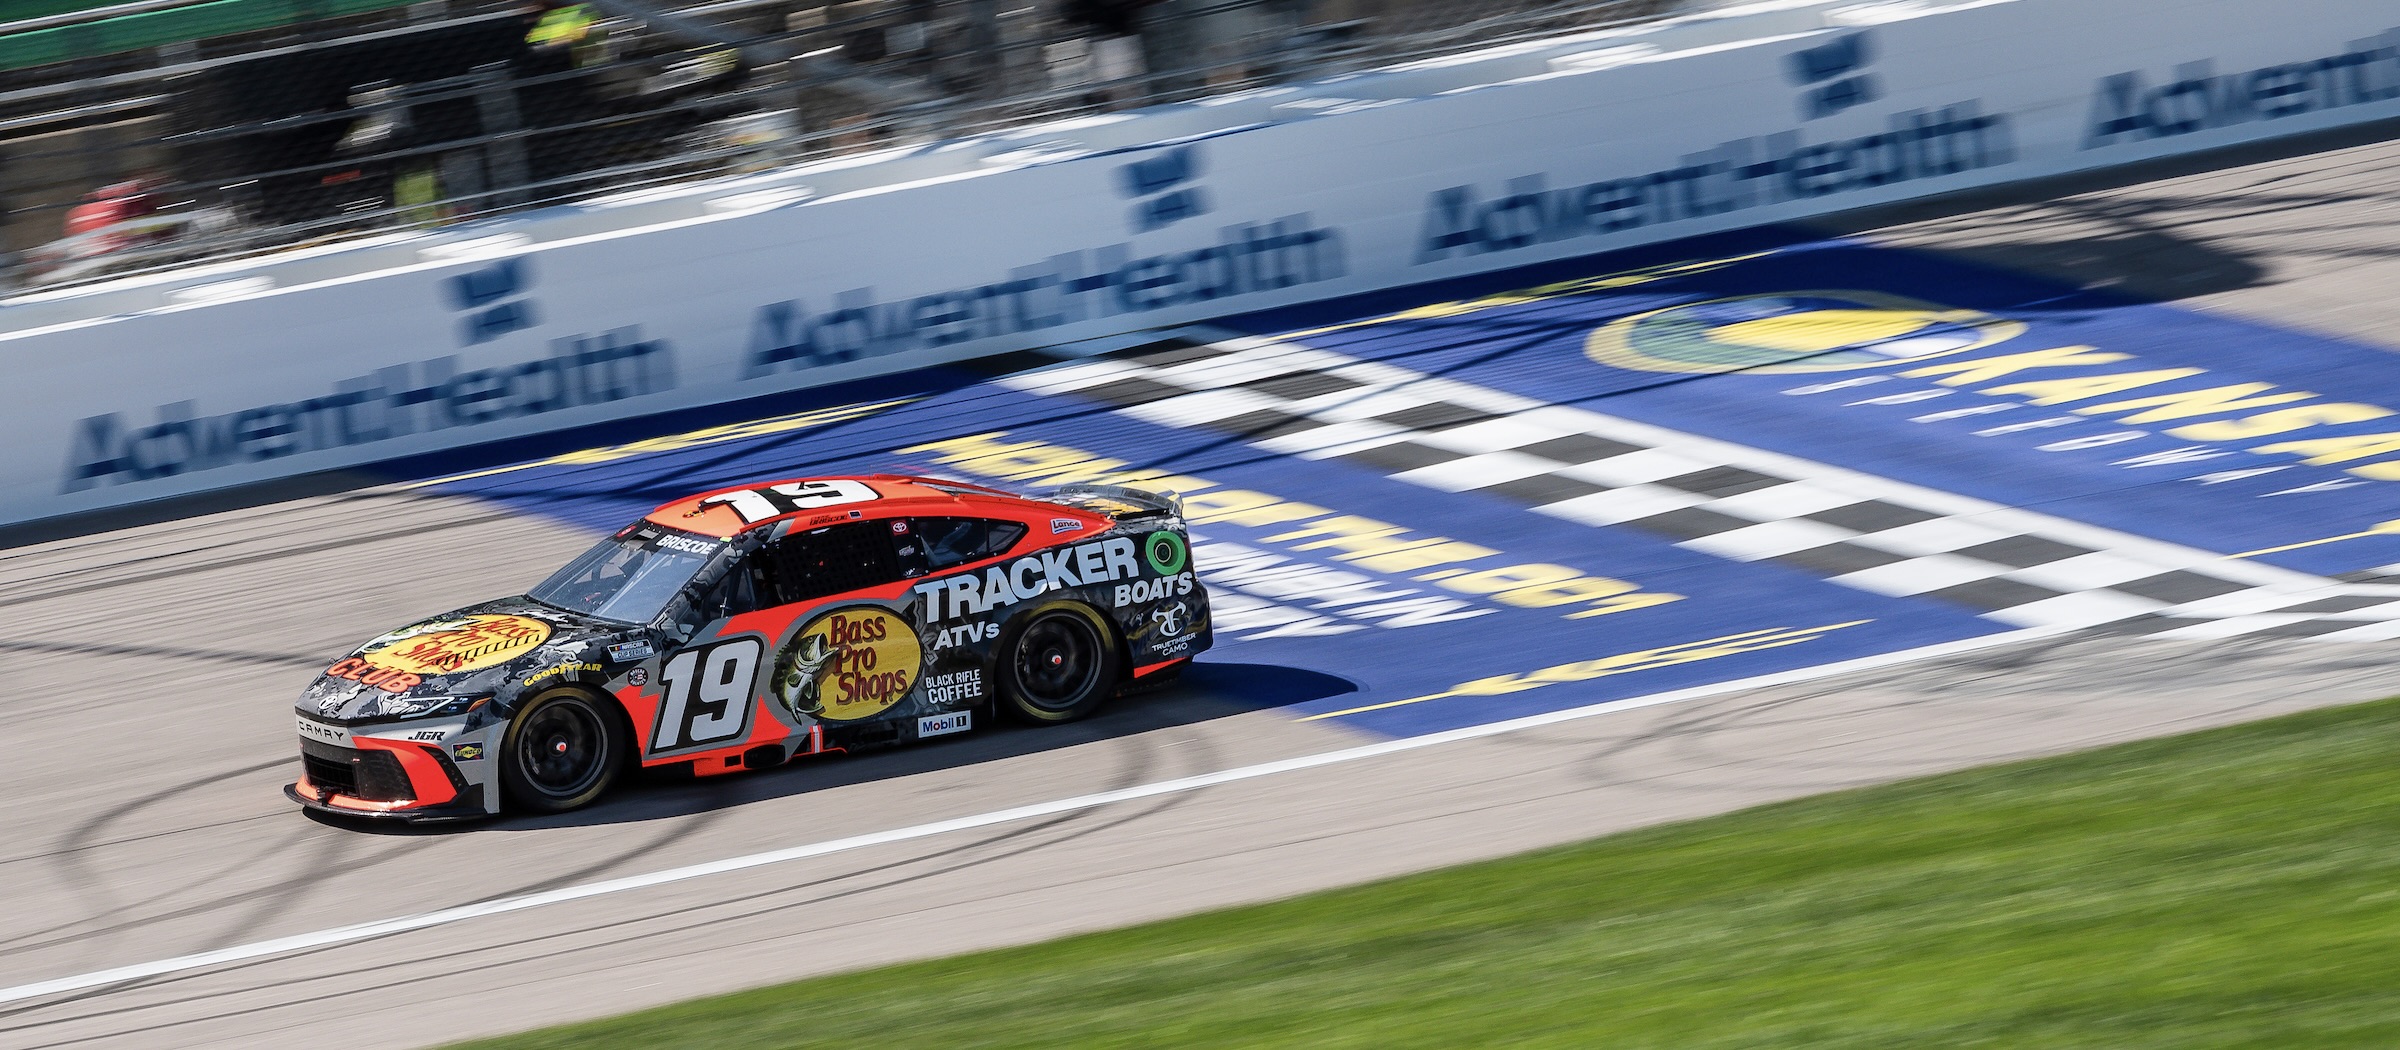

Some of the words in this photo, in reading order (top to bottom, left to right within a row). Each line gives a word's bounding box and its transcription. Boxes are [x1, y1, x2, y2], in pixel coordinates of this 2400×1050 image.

[2077, 26, 2400, 152] Advent
[704, 480, 879, 523] 19
[1053, 518, 1081, 528] Lance
[656, 534, 719, 556] BRISCOE
[914, 537, 1139, 624] TRACKER
[1114, 571, 1193, 608] BOATS
[829, 614, 886, 648] Bass
[933, 621, 1000, 651] ATVs
[1152, 632, 1197, 652] TRUETIMBER
[834, 645, 877, 675] Pro
[1162, 642, 1188, 656] CAMO
[327, 657, 422, 693] CLUB
[523, 663, 602, 687] GOODYEAR
[836, 668, 908, 706] Shops
[925, 673, 955, 688] BLACK
[956, 669, 980, 684] RIFLE
[655, 640, 760, 750] 19
[927, 681, 982, 704] COFFEE
[298, 720, 344, 742] CAMRY
[407, 731, 446, 742] JGR
[922, 717, 954, 733] Mobil
[455, 748, 482, 759] SUNOCO
